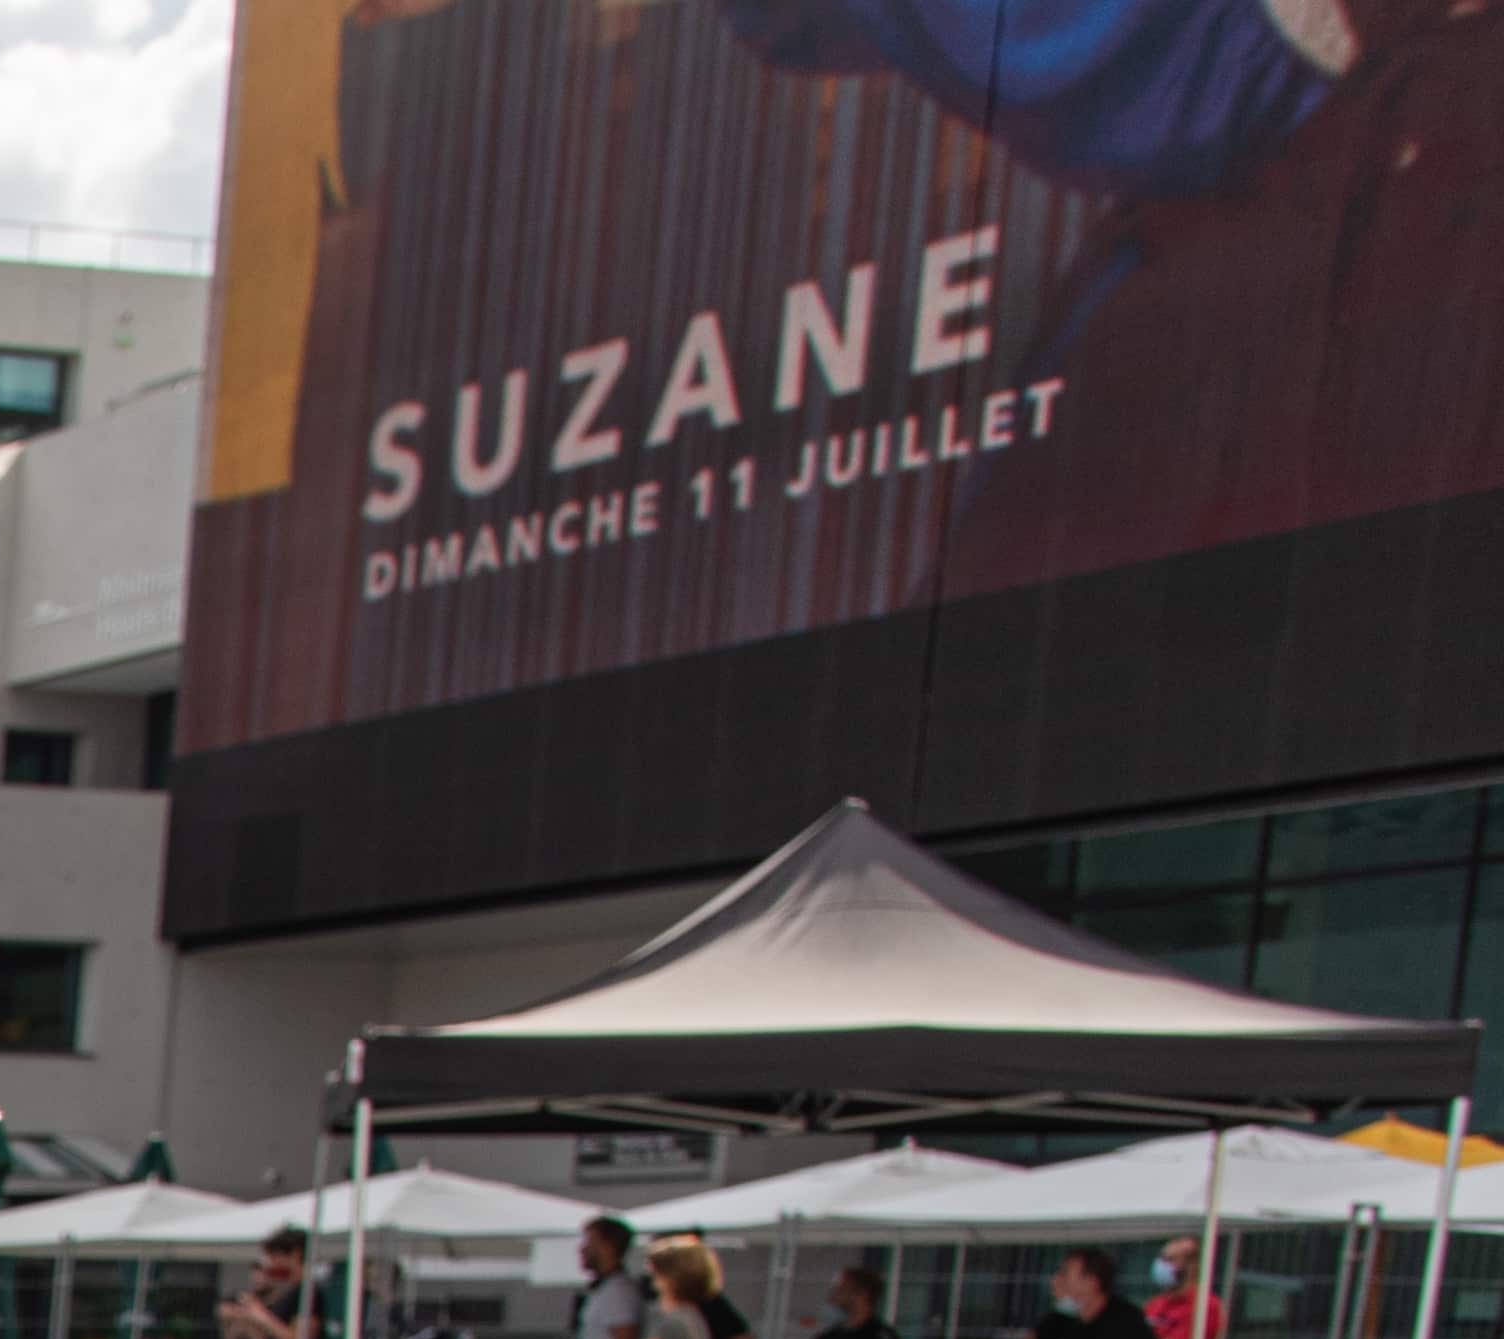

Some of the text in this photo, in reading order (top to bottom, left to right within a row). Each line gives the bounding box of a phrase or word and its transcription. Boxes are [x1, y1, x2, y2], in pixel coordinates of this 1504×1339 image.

[364, 225, 1000, 522] SUZANE
[364, 378, 1065, 599] DIMANCHE 11 JUILLET
